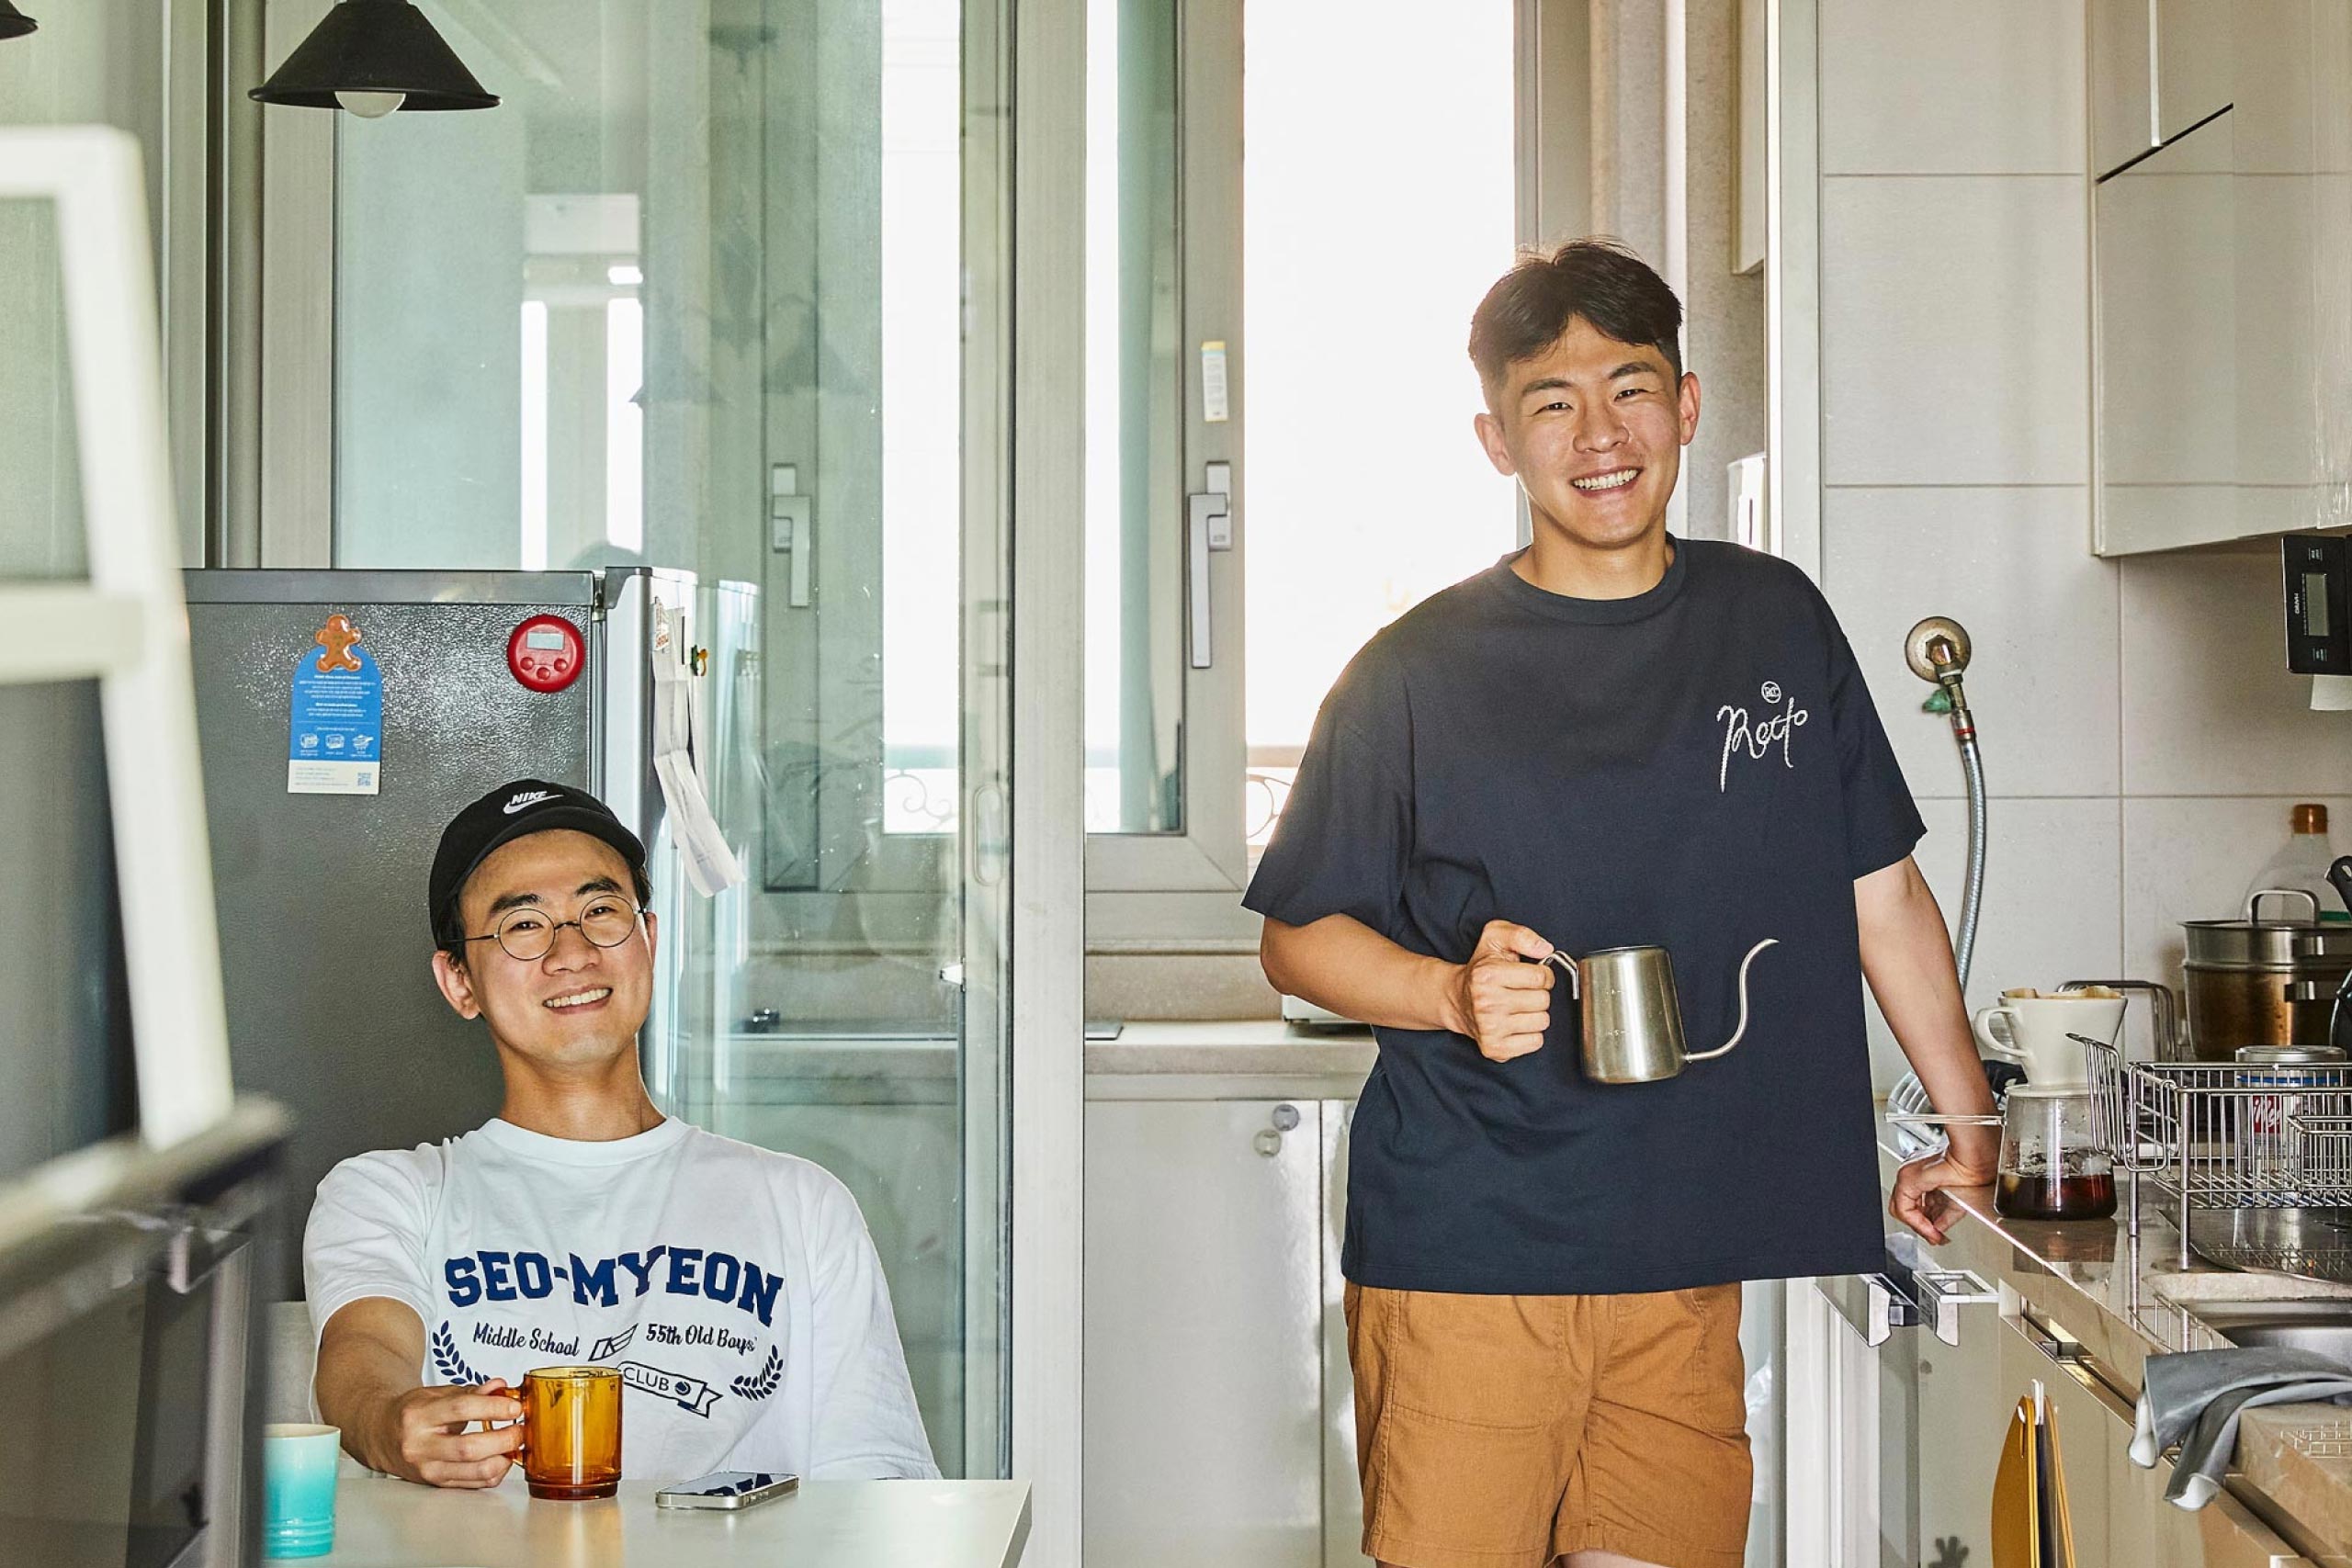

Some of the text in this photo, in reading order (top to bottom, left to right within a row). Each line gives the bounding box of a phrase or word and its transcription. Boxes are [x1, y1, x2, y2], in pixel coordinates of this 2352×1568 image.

[512, 791, 548, 805] NIKE
[445, 1245, 784, 1327] SEO-MYEON
[472, 1321, 526, 1348] Middle
[529, 1327, 580, 1357] School
[646, 1323, 683, 1345] 55th
[685, 1325, 714, 1346] Old
[624, 1367, 670, 1392] CLUB
